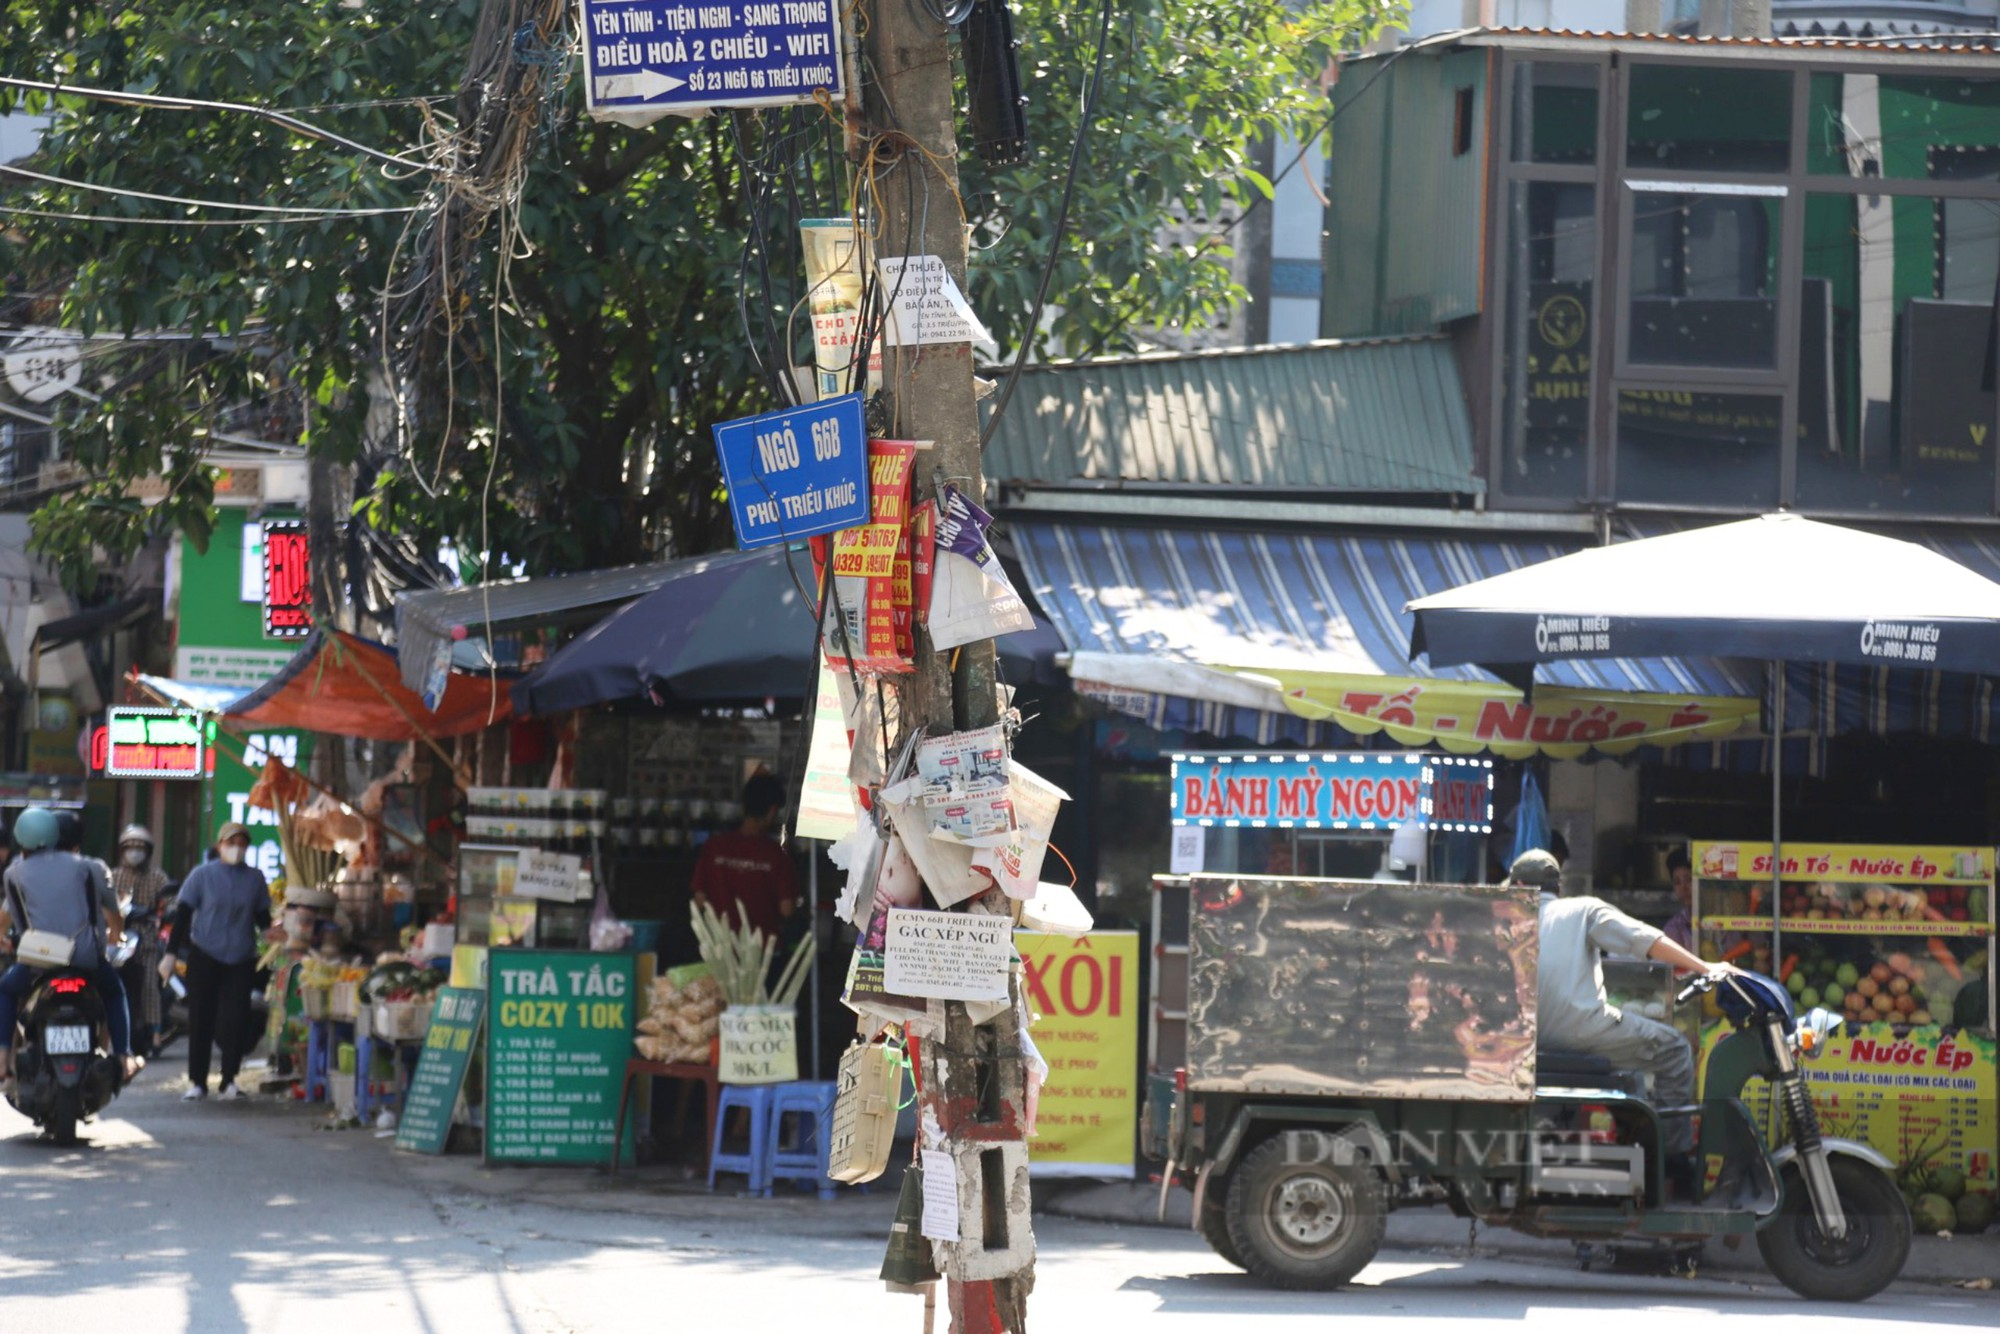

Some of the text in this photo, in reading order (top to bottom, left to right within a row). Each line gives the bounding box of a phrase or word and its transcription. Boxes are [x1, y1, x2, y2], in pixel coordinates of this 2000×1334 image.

[593, 1, 827, 35] YÊN TĨNH TIỆN NGHI SANG TRỌNG
[597, 31, 830, 67] ĐIỀU HOÀ 2 CHIỀU WIFI
[689, 62, 833, 92] SỐ 23 NGÕ 66 TRIỀU KHÚC
[886, 261, 935, 274] CHO THUÊ
[816, 318, 845, 329] CHO
[756, 417, 841, 474] NGÕ 66B
[746, 478, 857, 527] PHỐ TRIỀU KHÚC
[880, 491, 900, 517] KÍN
[1547, 618, 1579, 634] MINH
[1874, 623, 1909, 640] MINH
[1910, 624, 1940, 643] HIẾU
[243, 734, 297, 768] AN
[1184, 766, 1421, 820] BÁNH MỲ NGON
[1805, 853, 1831, 874] Tố
[1850, 857, 1904, 876] Nước
[1910, 854, 1937, 880] Ép
[895, 913, 925, 923] CCMN
[927, 914, 944, 924] 66B
[899, 923, 932, 939] GÁC
[500, 963, 625, 997] TRÀ TẮC
[1021, 936, 1122, 1017] XÔI
[500, 1001, 625, 1029] COZY 10K
[1850, 1034, 1974, 1072] Nước Ép
[1813, 1071, 1830, 1081] HOA
[1832, 1069, 1850, 1083] QUẢ
[1852, 1070, 1870, 1084] CÁC
[1873, 1073, 1892, 1086] LOẠI
[1913, 1076, 1930, 1087] MIX
[1932, 1075, 1950, 1088] CÁC
